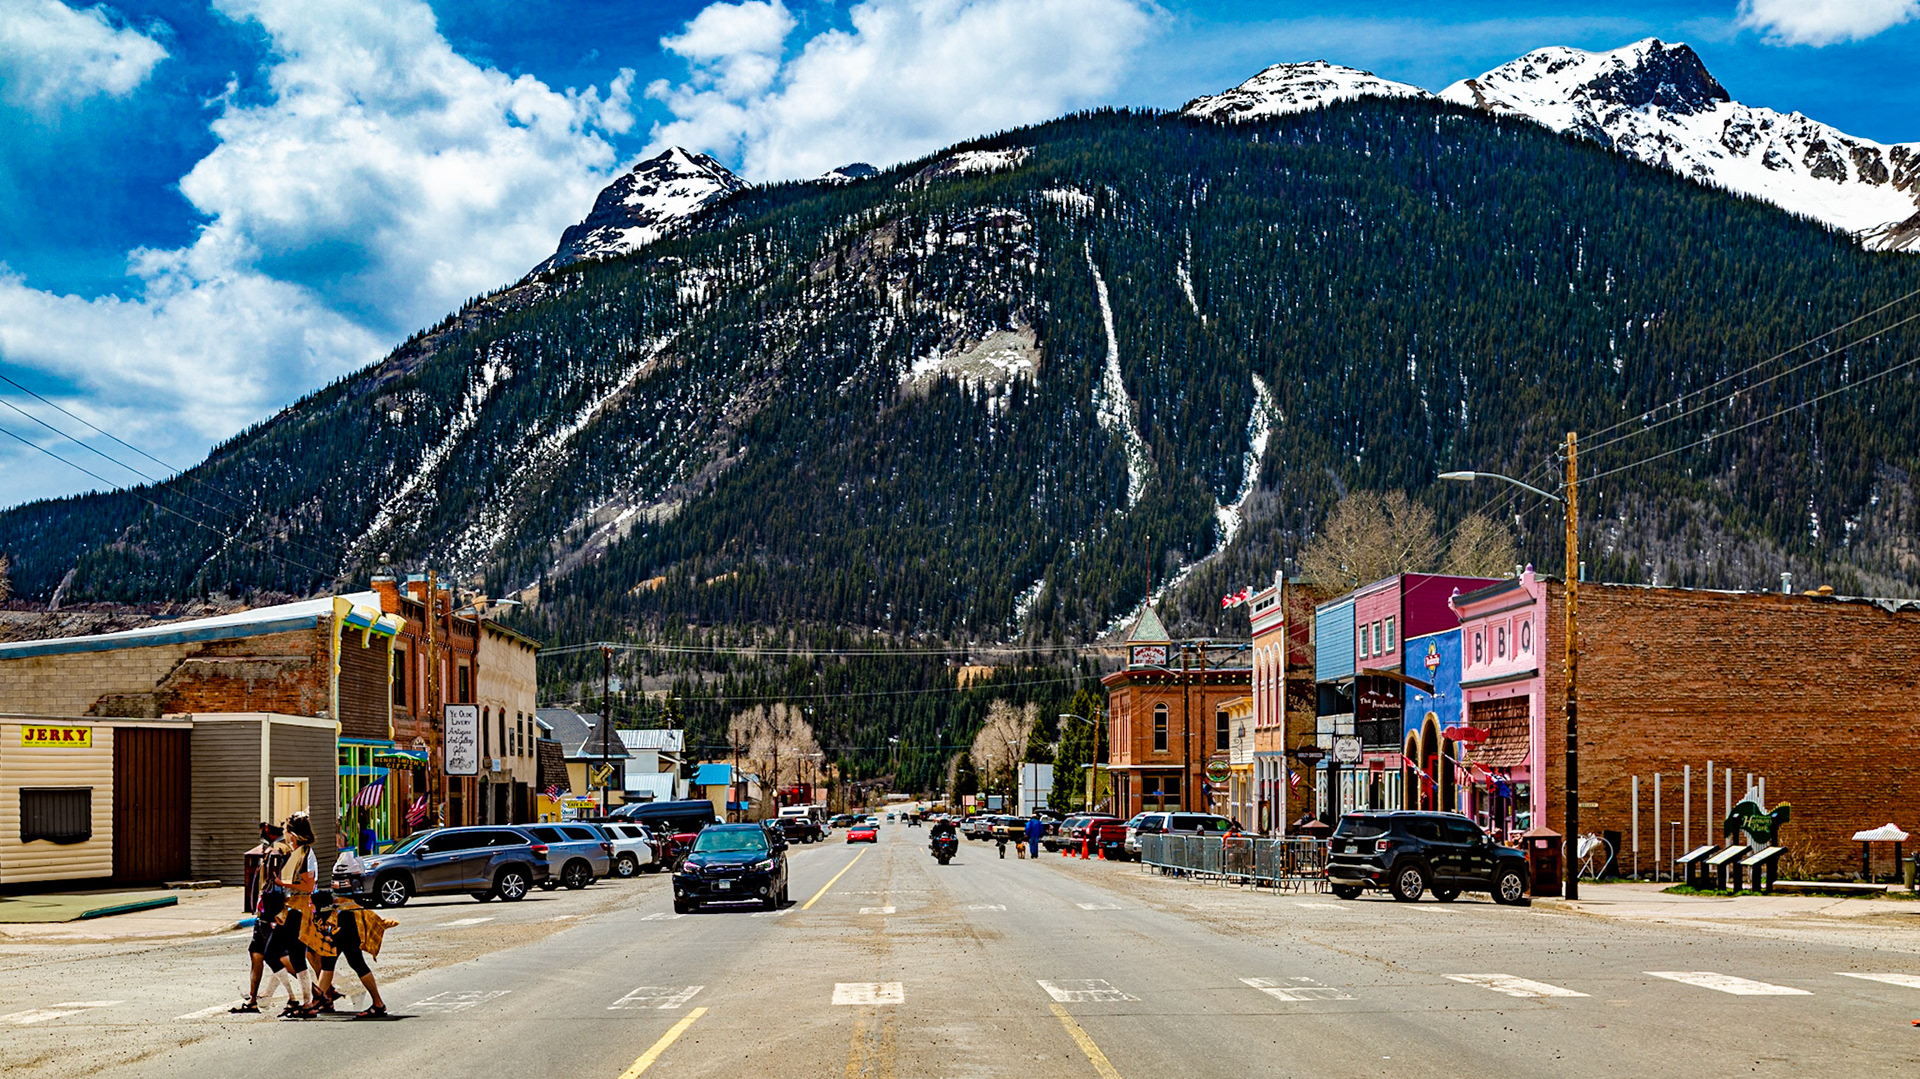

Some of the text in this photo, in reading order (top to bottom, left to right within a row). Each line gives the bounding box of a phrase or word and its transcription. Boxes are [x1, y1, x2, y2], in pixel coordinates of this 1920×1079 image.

[1476, 620, 1530, 663] BBQ
[1372, 700, 1401, 708] Avalanche
[25, 728, 87, 741] JERKY
